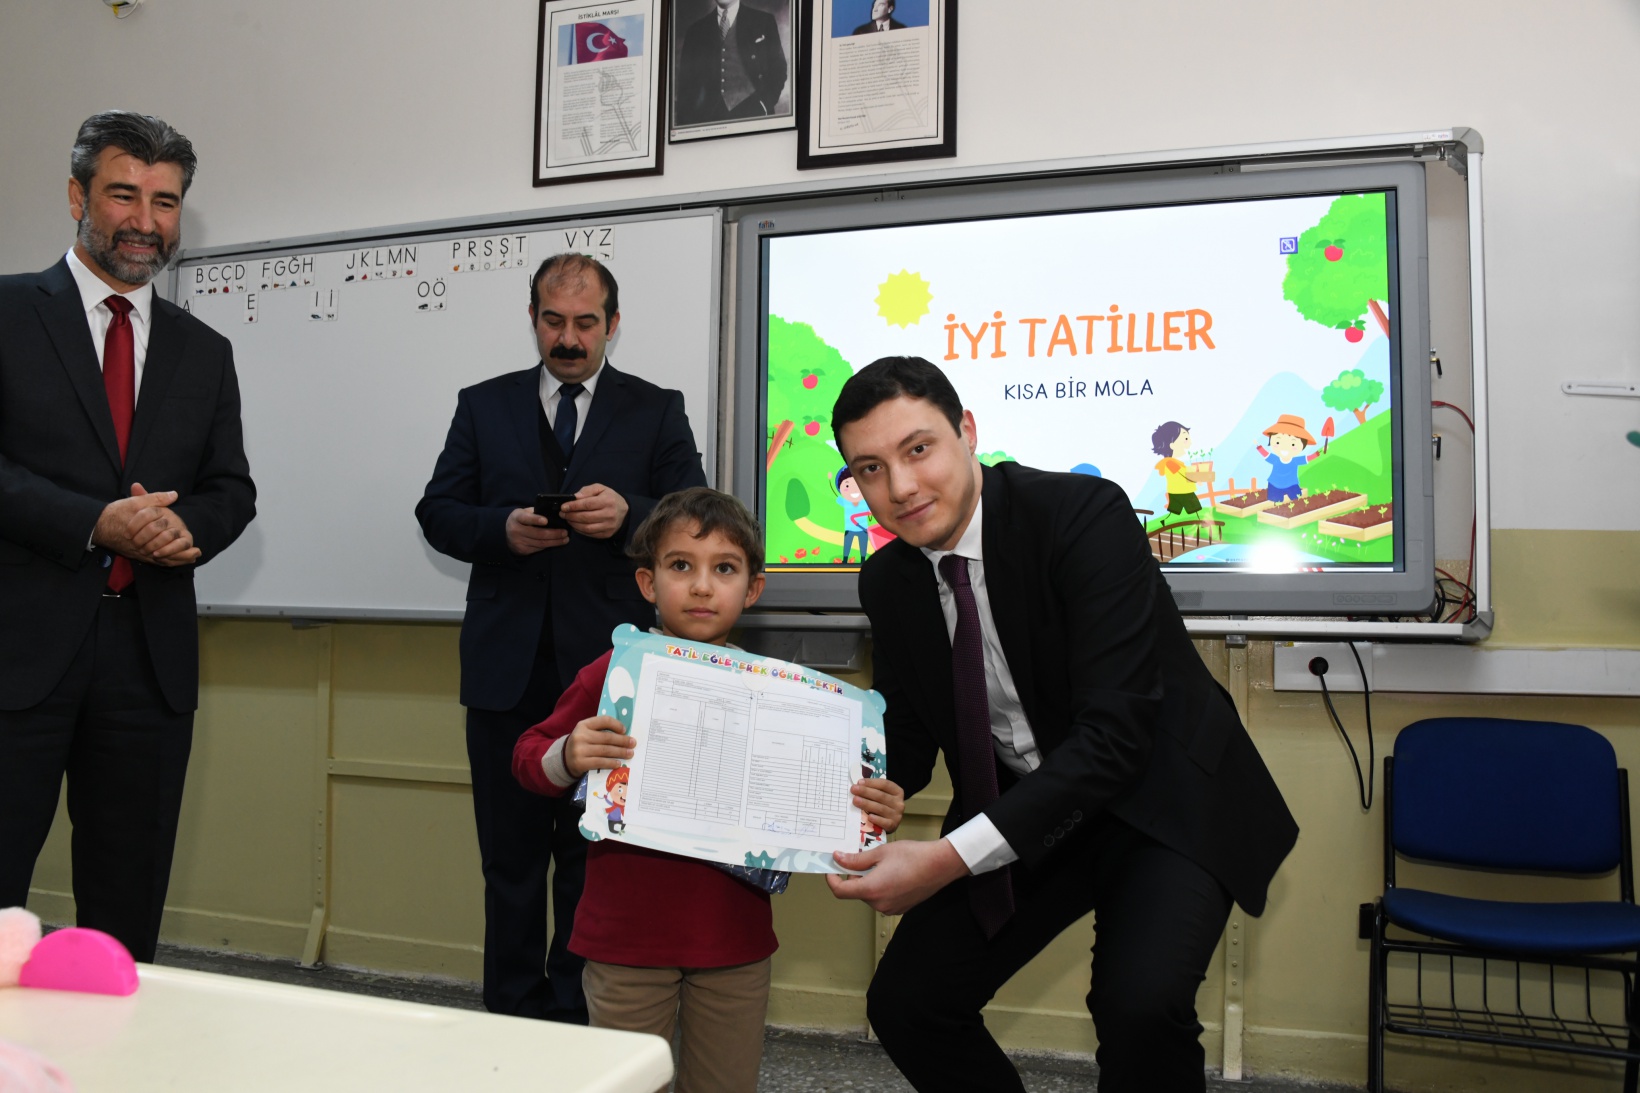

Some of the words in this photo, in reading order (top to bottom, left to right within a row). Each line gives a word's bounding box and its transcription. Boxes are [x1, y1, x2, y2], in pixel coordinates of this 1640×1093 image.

[247, 294, 255, 309] E
[943, 310, 1007, 361] İYİ
[1018, 304, 1216, 358] TATİLLER
[1004, 383, 1048, 400] KISA
[1055, 376, 1087, 399] BİR
[1095, 379, 1154, 397] MOLA
[666, 644, 699, 660] TATİL
